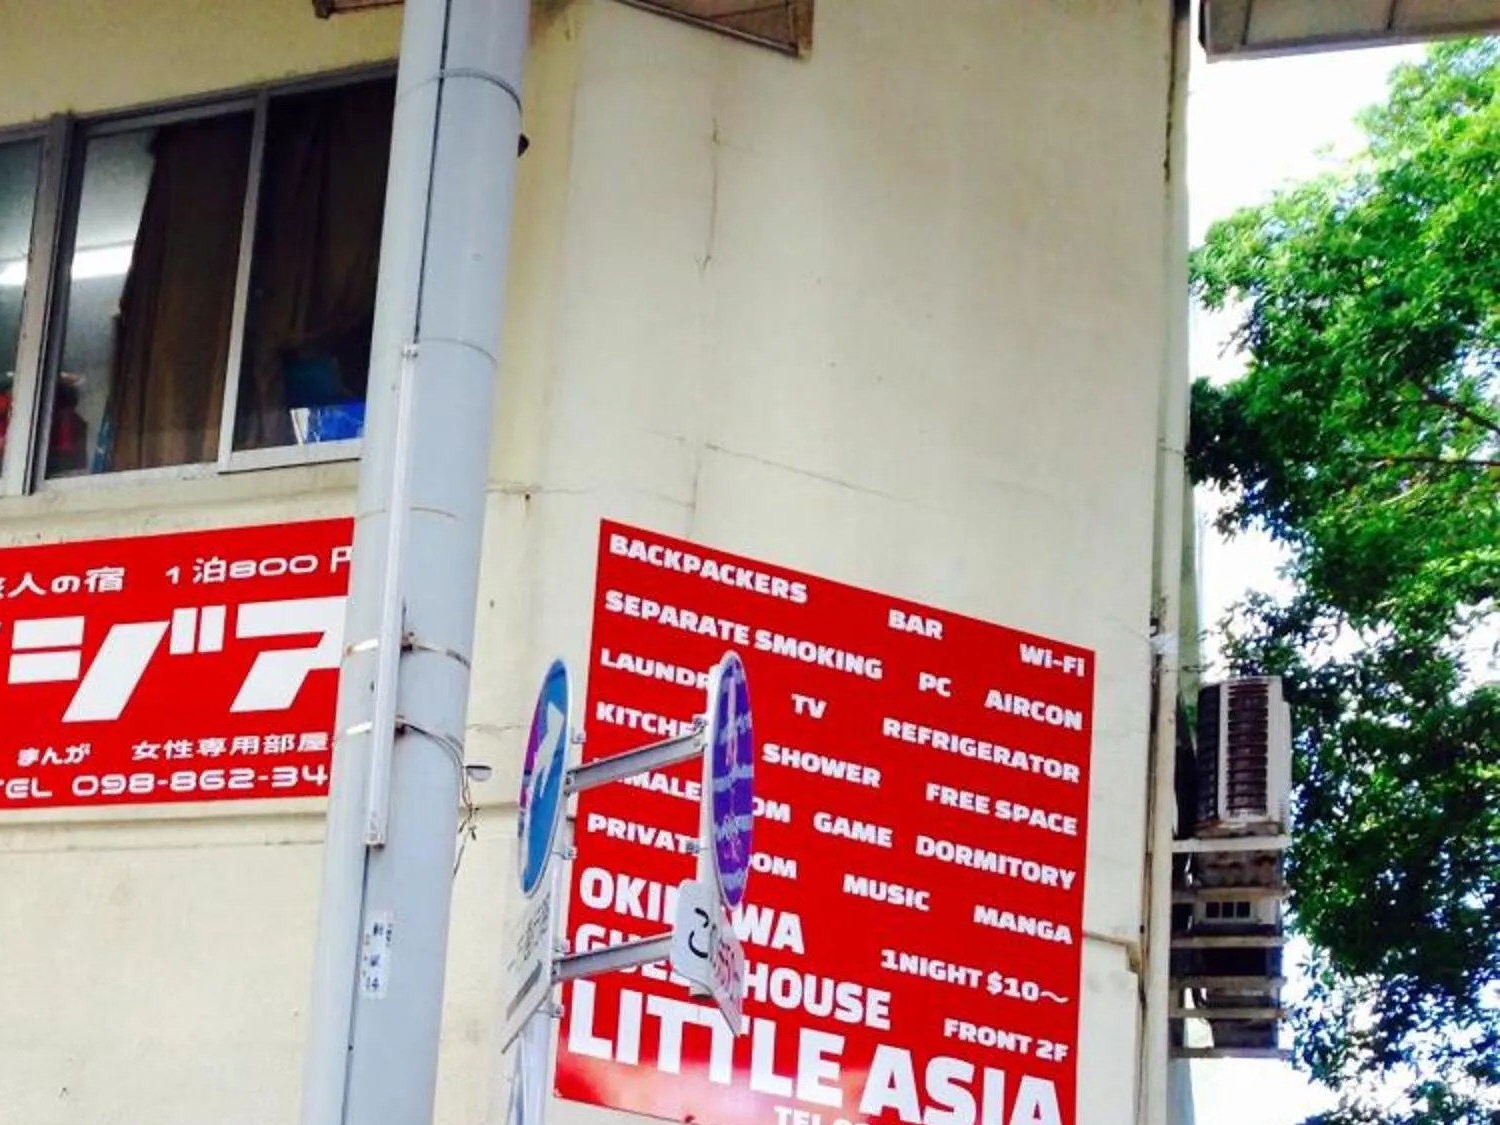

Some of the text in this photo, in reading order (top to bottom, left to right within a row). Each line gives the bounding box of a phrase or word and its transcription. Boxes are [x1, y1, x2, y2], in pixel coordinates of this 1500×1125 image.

[609, 533, 807, 604] BACKPACKERS
[605, 591, 883, 681] SEPARATE SMOKING
[888, 609, 944, 640] BAR
[601, 648, 710, 690] LAUNDR
[1020, 643, 1085, 678] Wi-Fi
[919, 671, 952, 698] PC
[595, 701, 698, 738] KITCHE
[791, 694, 827, 720] TV
[985, 688, 1083, 731] AIRCON
[16, 743, 91, 767] まんが
[762, 743, 882, 788] SHOWER
[883, 717, 1080, 783] REFRIGERATOR
[72, 764, 329, 797] 098-862-34
[926, 781, 1077, 835] FREE SPACE
[587, 812, 700, 856] PRIVAT
[813, 811, 893, 848] GAME
[916, 834, 1076, 892] DORMITORY
[843, 873, 930, 912] MUSIC
[972, 903, 1073, 945] MANGA
[881, 948, 983, 989] 1NIGHT
[743, 961, 891, 1031] HOUSE
[567, 980, 845, 1110] LITTLE
[943, 1017, 1069, 1062] FRONT 2F
